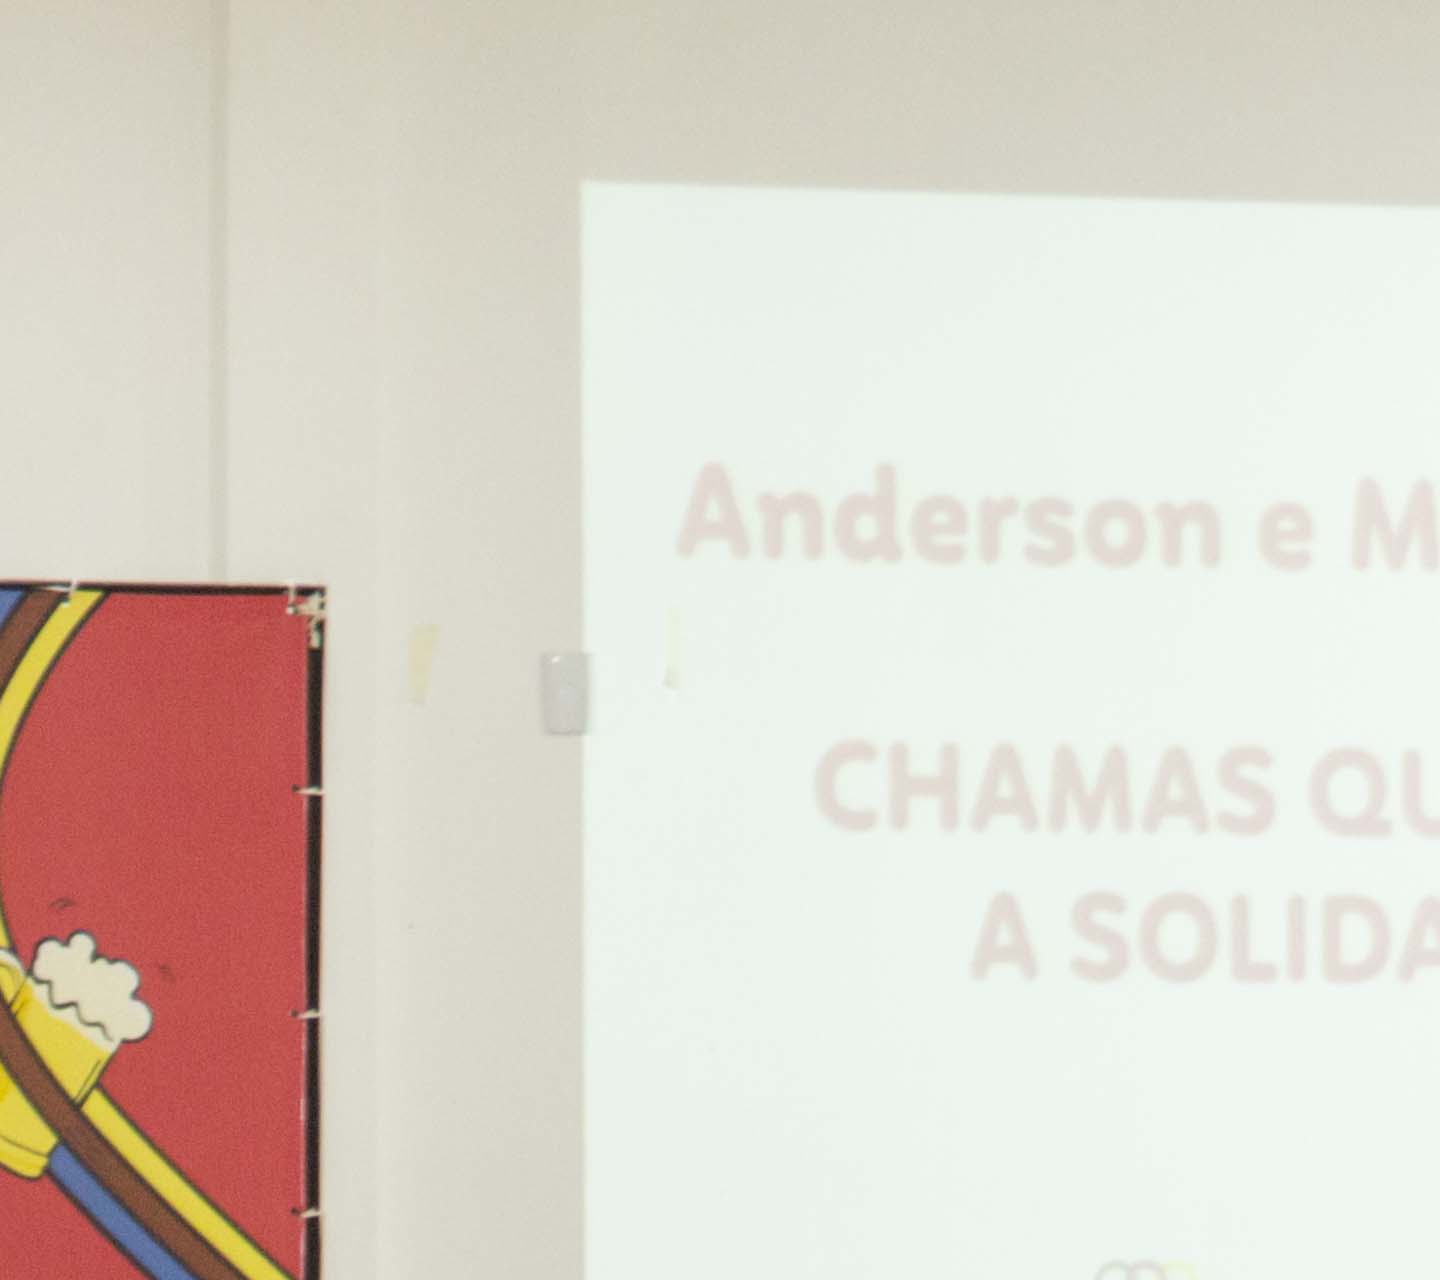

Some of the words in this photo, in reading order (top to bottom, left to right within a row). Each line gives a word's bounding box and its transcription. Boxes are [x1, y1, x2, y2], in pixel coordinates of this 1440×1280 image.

[674, 461, 1222, 568] Anderson
[1258, 500, 1315, 571] e
[813, 738, 1277, 836] CHAMAS
[970, 891, 1040, 981] A
